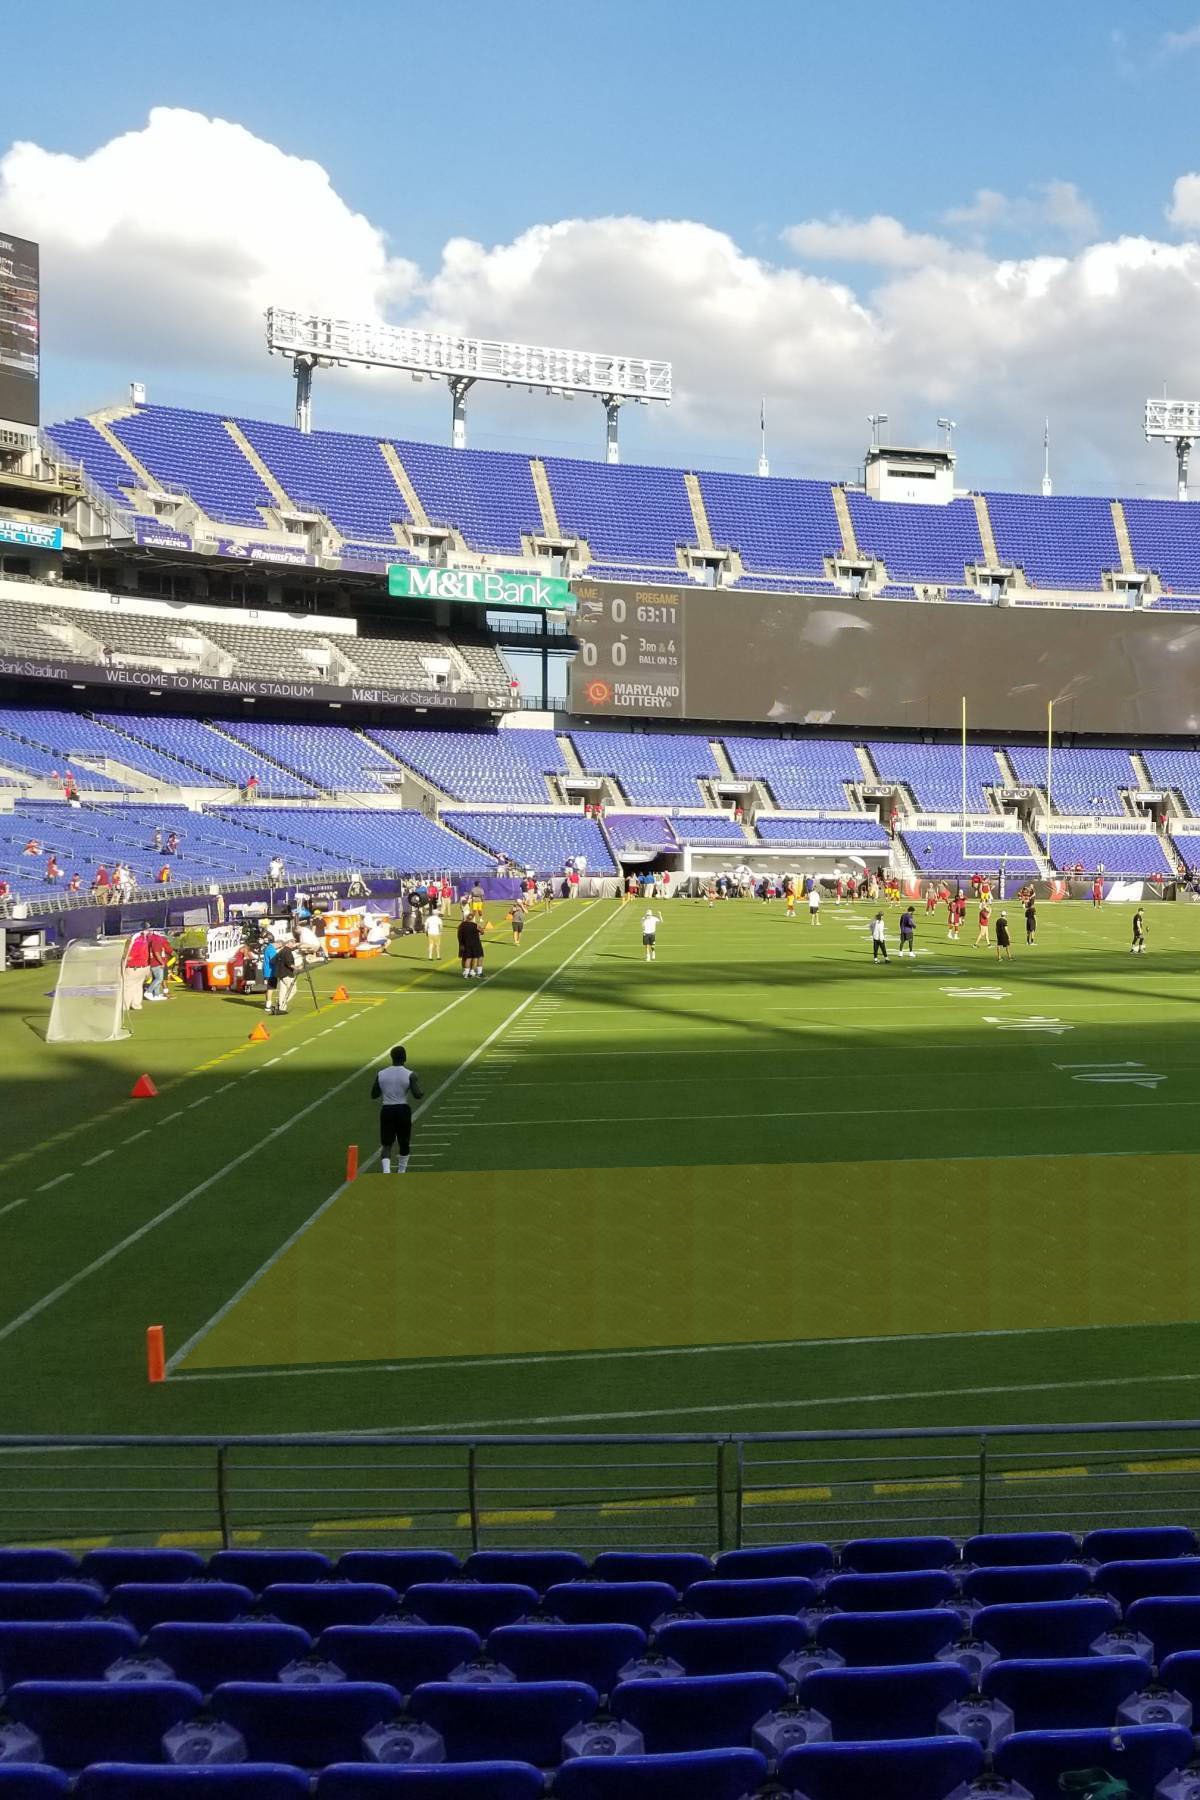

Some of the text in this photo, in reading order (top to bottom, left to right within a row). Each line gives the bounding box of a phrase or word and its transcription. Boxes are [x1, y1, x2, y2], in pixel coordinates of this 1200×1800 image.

[143, 537, 188, 548] RAVENS
[251, 549, 306, 564] #RavensFlock
[407, 567, 553, 606] M&T Bank
[635, 591, 679, 605] PREGAME
[612, 598, 626, 623] 0
[636, 606, 677, 624] 63:11
[668, 639, 675, 653] 4
[612, 642, 626, 666] 0
[639, 655, 656, 664] BALL
[657, 656, 667, 665] ON
[25, 662, 68, 679] Stadium
[106, 670, 314, 697] WELCOME TO M&T BANK STADIUM
[615, 683, 679, 697] MARYLAND
[351, 689, 457, 707] M&T Bank Stadium
[615, 694, 667, 707] LOTTERY
[212, 966, 227, 979] G
